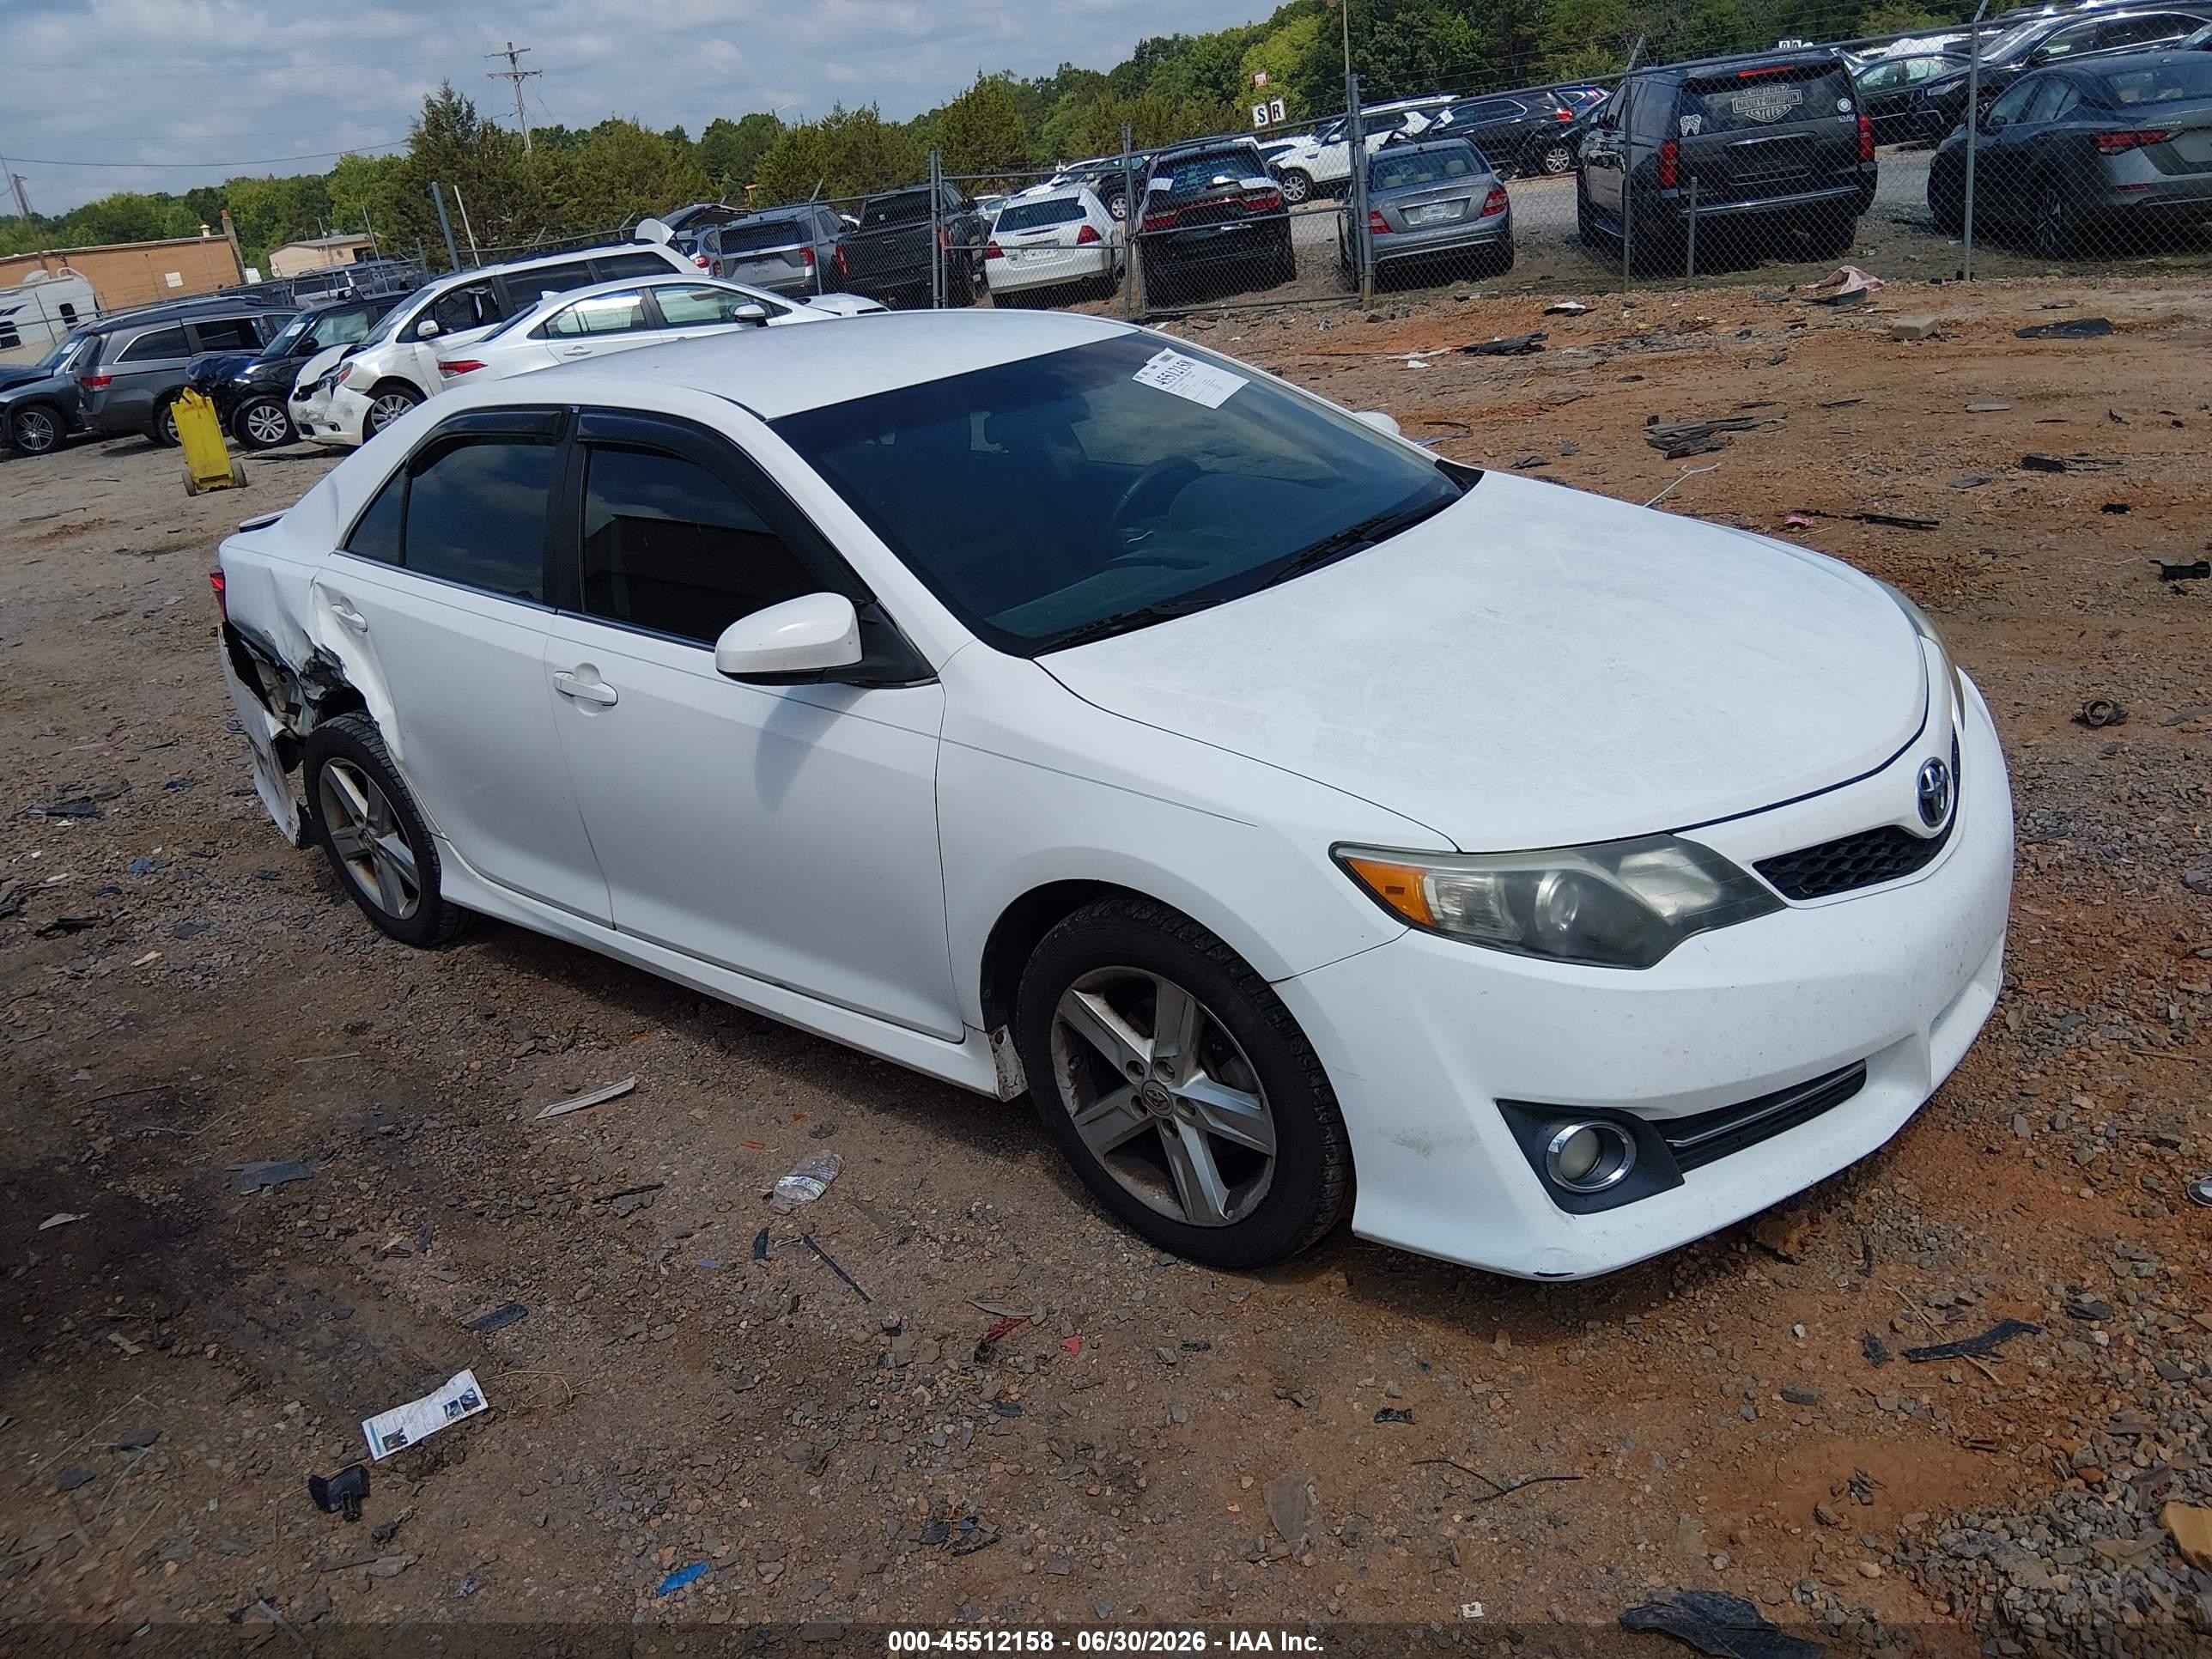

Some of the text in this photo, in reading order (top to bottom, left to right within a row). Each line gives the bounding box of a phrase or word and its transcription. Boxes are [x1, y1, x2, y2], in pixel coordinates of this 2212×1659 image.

[1737, 93, 1798, 109] HARLEY-DAVIDSON
[1257, 104, 1281, 124] S R
[1753, 105, 1784, 118] CYCLES
[1153, 359, 1195, 386] 45512158
